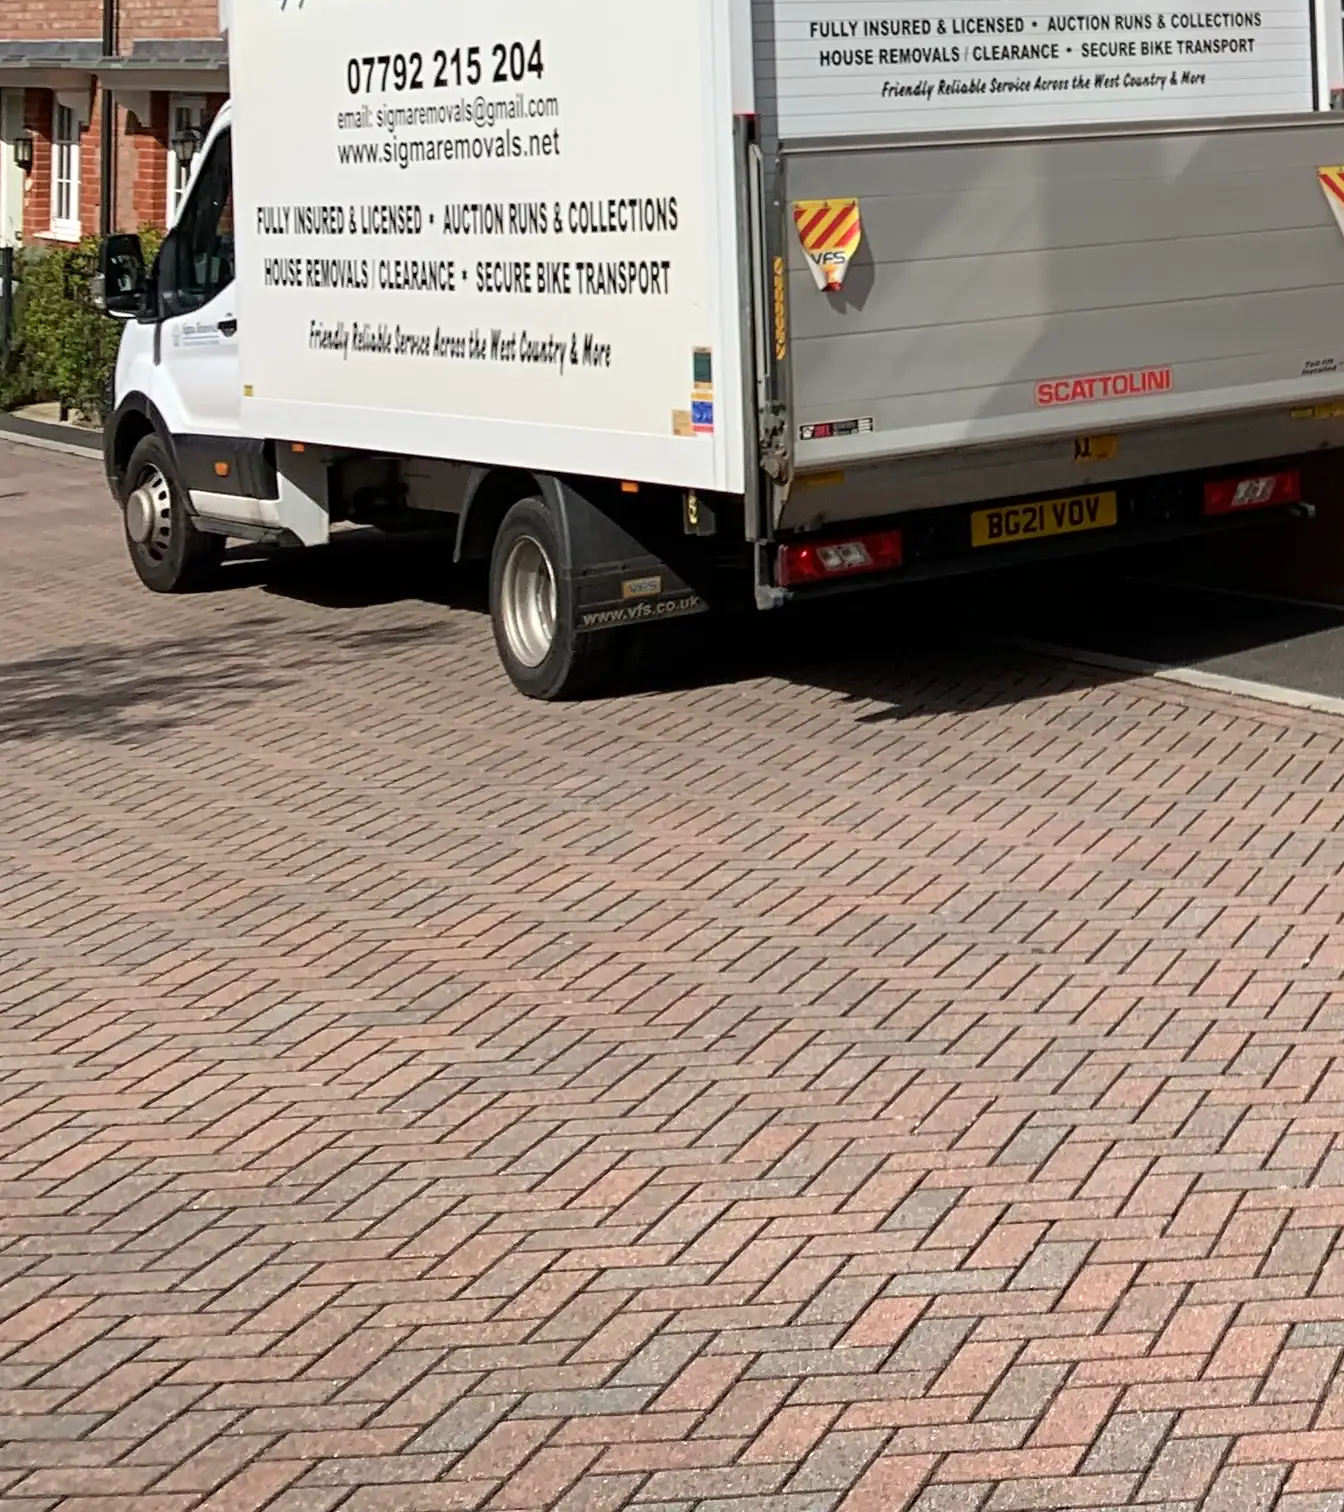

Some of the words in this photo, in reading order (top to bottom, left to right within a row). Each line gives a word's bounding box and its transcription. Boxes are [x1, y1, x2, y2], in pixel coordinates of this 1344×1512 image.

[810, 21, 857, 38] FULLY
[864, 20, 931, 37] INSURED
[936, 19, 947, 35] &
[952, 17, 1024, 34] LICENSED
[1048, 15, 1110, 32] AUCTION
[1115, 14, 1152, 30] RUNS
[1157, 13, 1166, 29] &
[1171, 12, 1262, 29] COLLECTIONS
[347, 52, 424, 94] 07792
[433, 46, 481, 88] 215
[492, 39, 544, 82] 204
[820, 49, 874, 67] HOUSE
[879, 47, 960, 64] REMOVALS
[973, 43, 1060, 61] CLEARANCE
[1081, 41, 1136, 57] SECURE
[1141, 40, 1172, 56] BIKE
[1177, 38, 1255, 54] TRANSPORT
[881, 81, 935, 101] Friendly
[938, 77, 986, 96] Reliable
[990, 77, 1035, 94] Service
[1034, 76, 1069, 92] Across
[1072, 74, 1091, 90] the
[1094, 73, 1120, 89] West
[1123, 72, 1167, 91] Country
[1170, 71, 1178, 85] &
[1182, 70, 1206, 85] More
[337, 104, 373, 130] email:
[376, 93, 559, 133] sigmaremovals@gmail.com
[337, 127, 560, 169] www.sigmaremovals.net
[257, 206, 290, 234] FULLY
[294, 206, 344, 234] INSURED
[350, 205, 356, 234] &
[361, 205, 422, 234] LICENSED
[443, 203, 504, 234] AUCTION
[509, 202, 548, 234] RUNS
[554, 202, 563, 234] &
[569, 196, 678, 234] COLLECTIONS
[264, 258, 302, 287] HOUSE
[306, 259, 368, 289] REMOVALS
[379, 260, 455, 291] CLEARANCE
[476, 261, 532, 293] SECURE
[537, 261, 571, 294] BIKE
[576, 260, 671, 295] TRANSPORT
[811, 251, 846, 265] VFS
[309, 319, 350, 361] Friendly
[394, 324, 430, 357] Service
[433, 326, 465, 359] Across
[469, 327, 486, 360] the
[490, 328, 517, 362] West
[519, 330, 567, 376] Country
[570, 332, 578, 365] &
[582, 333, 611, 368] More
[1037, 369, 1170, 405] SCATTOLINI
[987, 505, 1044, 539] BG21
[1052, 496, 1100, 528] VOV
[583, 595, 700, 627] www.vfs.co.uk
